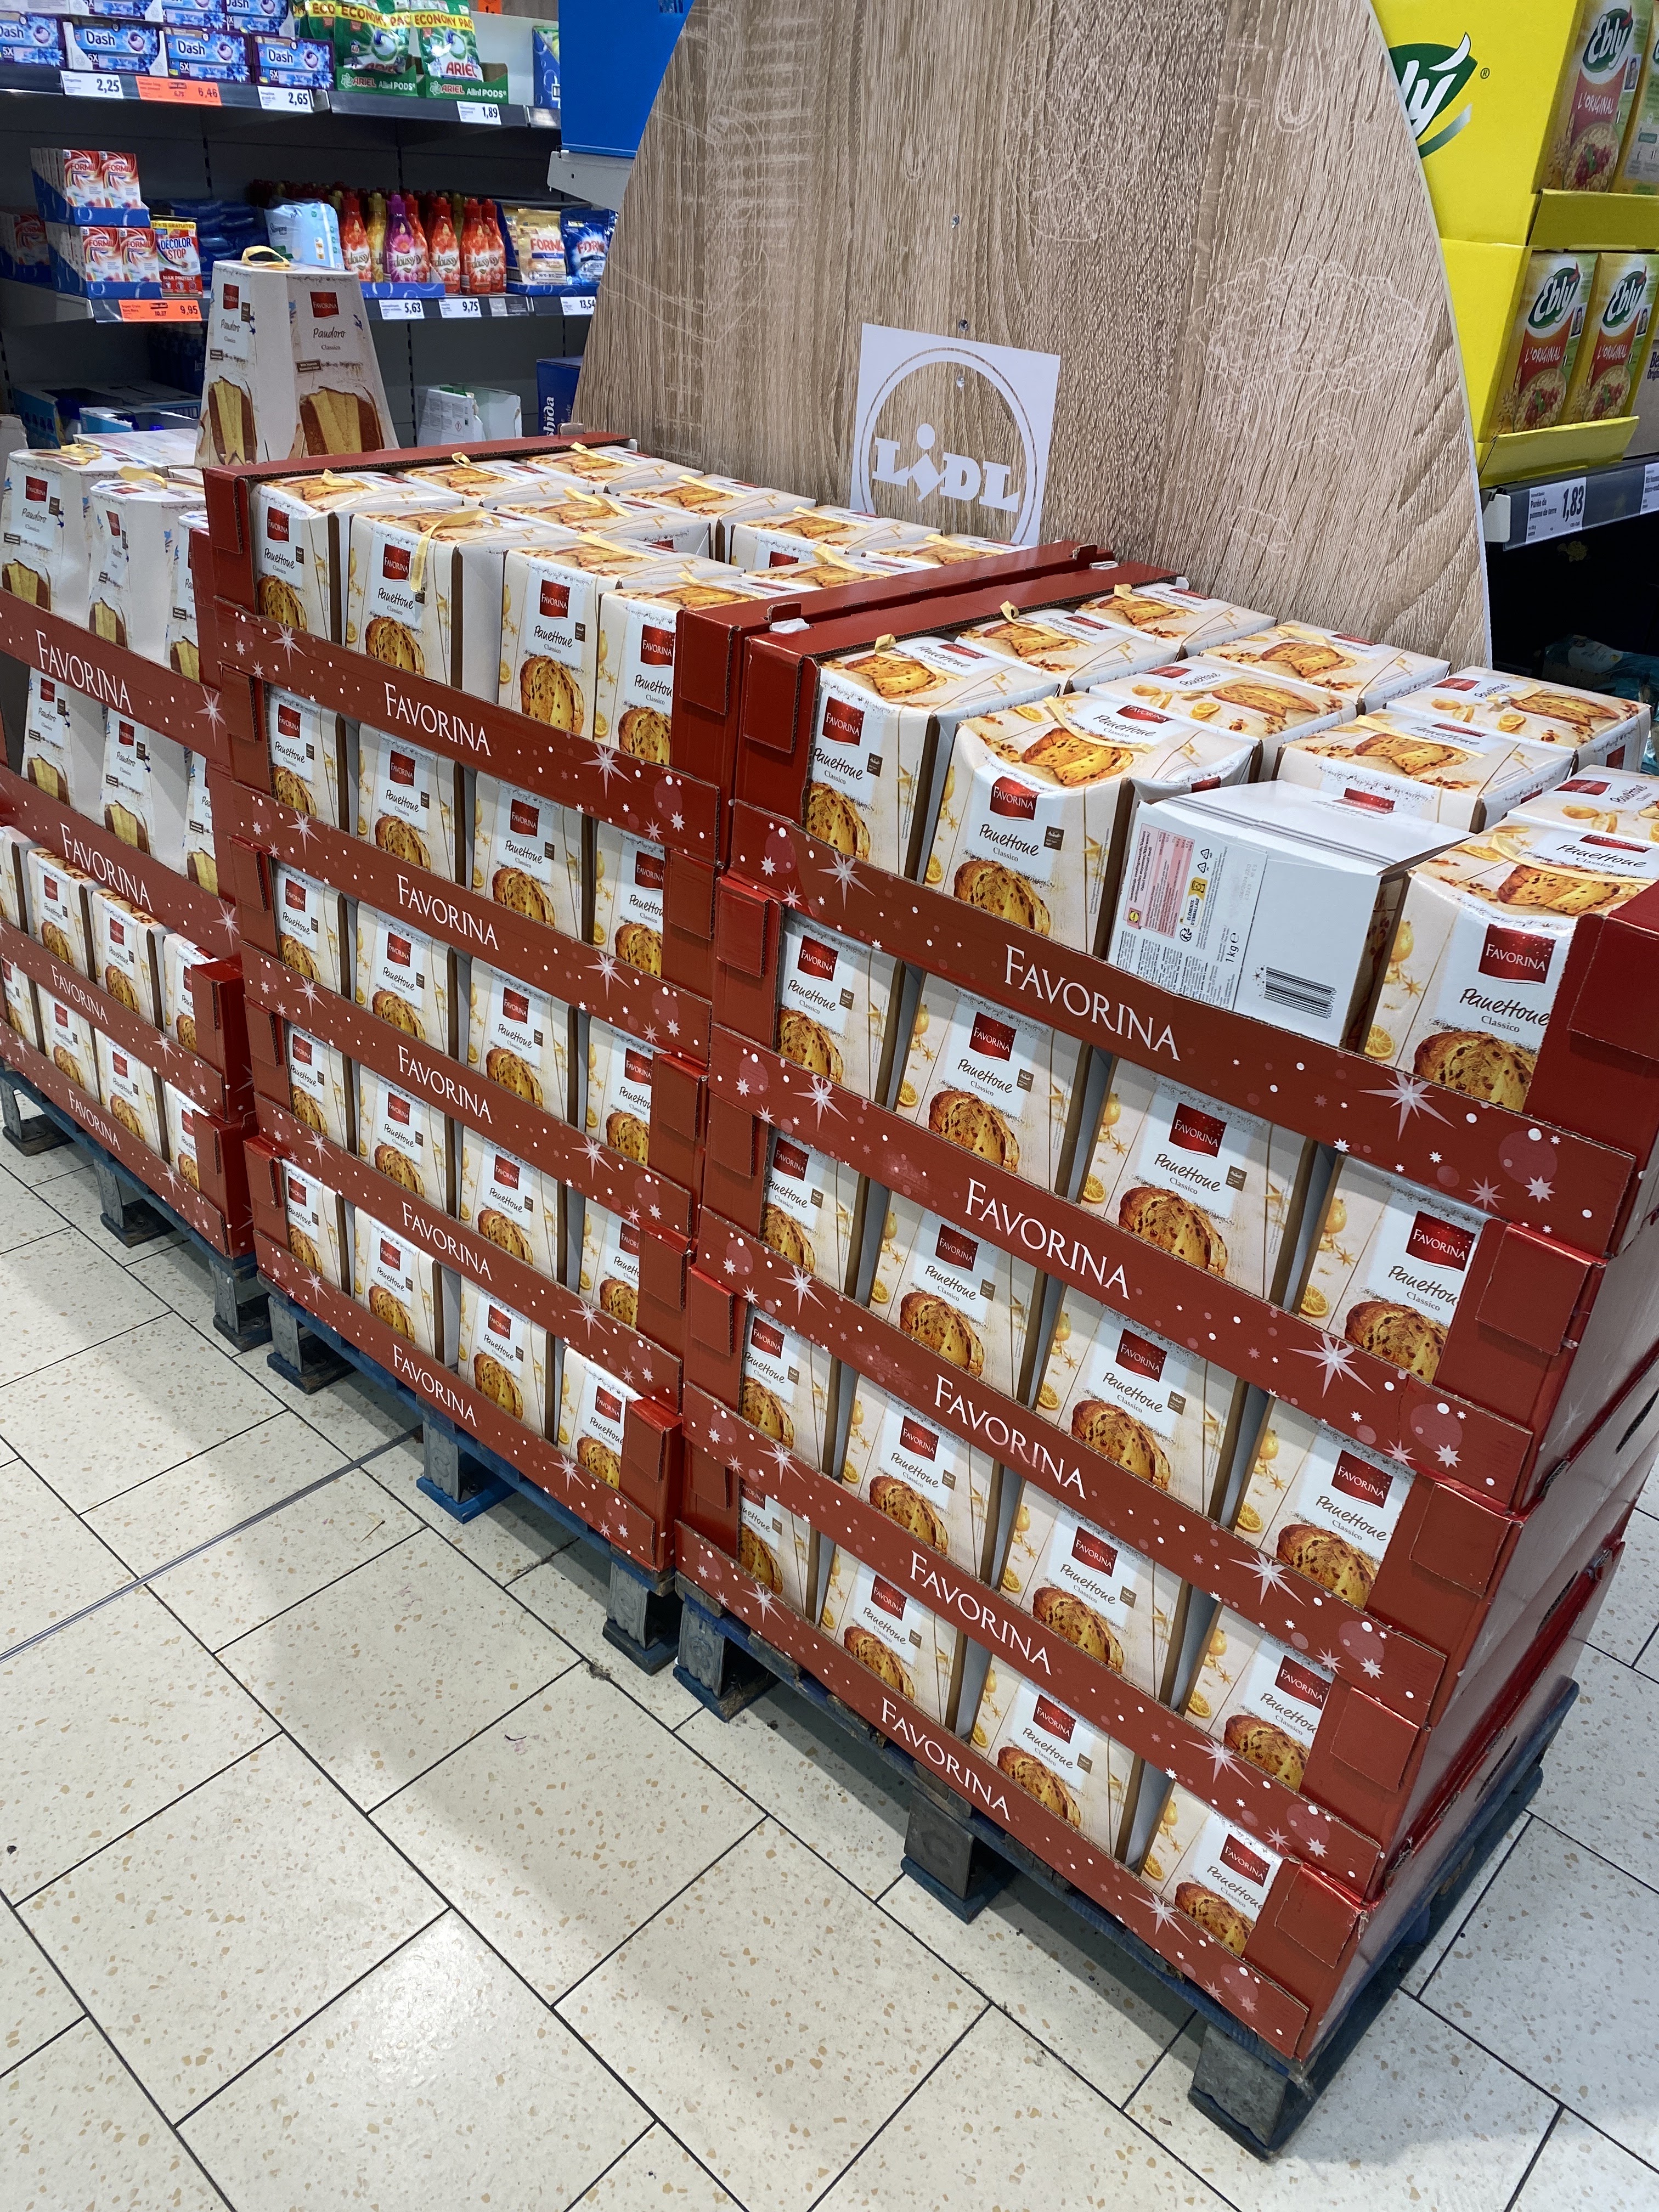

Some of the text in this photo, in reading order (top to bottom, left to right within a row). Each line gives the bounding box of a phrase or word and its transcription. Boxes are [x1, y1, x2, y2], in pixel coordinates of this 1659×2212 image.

[415, 14, 456, 27] ECONOMY
[86, 31, 115, 46] Dash
[178, 40, 205, 55] Dash
[1588, 14, 1629, 69] Ebly
[179, 62, 189, 71] 5X
[269, 49, 293, 63] Dash
[269, 70, 279, 79] 5X
[446, 61, 477, 77] ARIEL
[97, 78, 119, 93] 2,25
[198, 87, 217, 98] 6,46
[352, 77, 376, 87] ARIEL
[441, 84, 464, 94] ARIEL
[288, 92, 308, 105] 2,65
[1577, 92, 1614, 115] L'ORIGINAL
[483, 106, 498, 119] 1,89
[168, 249, 185, 259] STOP
[180, 306, 198, 315] 9,95
[313, 301, 337, 309] FAVORINA
[405, 302, 421, 314] 5,63
[462, 301, 478, 312] 9,75
[1535, 276, 1579, 324] Ebly
[1609, 278, 1641, 324] Ebly
[313, 327, 346, 338] Pandoro
[1525, 346, 1561, 364] L'ORIGINAL
[1597, 345, 1627, 360] L'ORIGINAL
[1563, 485, 1584, 522] 1,83
[268, 518, 289, 535] FAVORINA
[264, 548, 295, 569] Panettone
[385, 557, 408, 573] FAVORINA
[378, 588, 414, 610] Panettone
[541, 593, 567, 610] FAVORINA
[534, 625, 573, 647] Panettone
[642, 640, 672, 657] FAVORINA
[35, 629, 133, 714] FAVORINA
[634, 674, 673, 697] Panetton
[646, 694, 665, 705] Classico
[279, 715, 299, 732] FAVORINA
[385, 682, 491, 757] FAVORINA
[826, 712, 860, 737] FAVORINA
[1126, 705, 1167, 721] FAVORINA
[1093, 715, 1156, 736] Panettone
[275, 741, 305, 763] Panettone
[813, 747, 863, 780] Panettone
[391, 763, 413, 780] FAVORINA
[824, 769, 847, 786] Classico
[386, 789, 420, 812] Panettone
[993, 786, 1034, 811] FAVORINA
[512, 811, 537, 830] FAVORINA
[981, 823, 1040, 856] Panettone
[505, 840, 543, 864] Panettone
[993, 847, 1019, 862] Classico
[1556, 845, 1647, 867] Panettone
[60, 822, 153, 913] FAVORINA
[286, 889, 305, 906] FAVORINA
[283, 912, 310, 935] Panettone
[397, 873, 500, 951] FAVORINA
[388, 943, 410, 960] FAVORINA
[801, 949, 833, 973] FAVORINA
[1227, 945, 1239, 958] kg
[1485, 943, 1546, 972] FAVORINA
[383, 967, 415, 991] Panettone
[50, 964, 109, 1025] FAVORINA
[788, 979, 836, 1012] Panettone
[799, 999, 820, 1014] Classico
[1004, 943, 1181, 1062] FAVORINA
[504, 1000, 527, 1017] FAVORINA
[1459, 988, 1551, 1027] Panettone
[498, 1023, 532, 1048] Panettone
[1481, 1014, 1520, 1033] Classico
[974, 1027, 1011, 1052] FAVORINA
[627, 1059, 651, 1080] FAVORINA
[957, 1058, 1013, 1093] Panettone
[397, 1045, 493, 1124] FAVORINA
[970, 1080, 994, 1097] Classico
[69, 1088, 120, 1151] FAVORINA
[384, 1124, 415, 1148] Panettone
[1175, 1119, 1218, 1148] FAVORINA
[776, 1149, 805, 1174] FAVORINA
[1154, 1153, 1221, 1192] Panettone
[1170, 1176, 1198, 1195] Classico
[489, 1188, 522, 1213] Panettone
[402, 1201, 493, 1281] FAVORINA
[939, 1237, 973, 1264] FAVORINA
[964, 1177, 1130, 1300] FAVORINA
[1413, 1228, 1466, 1261] FAVORINA
[377, 1267, 405, 1291] Panettone
[925, 1265, 976, 1301] Panettone
[1388, 1265, 1459, 1306] Panetton
[1407, 1291, 1441, 1311] Classico
[484, 1334, 514, 1361] Panettone
[753, 1328, 781, 1352] FAVORINA
[1120, 1344, 1160, 1373] FAVORINA
[393, 1344, 477, 1427] FAVORINA
[1103, 1372, 1163, 1413] Panettone
[597, 1398, 620, 1418] FAVORINA
[902, 1427, 935, 1455] FAVORINA
[934, 1373, 1086, 1500] FAVORINA
[890, 1453, 939, 1488] Panettone
[1338, 1465, 1385, 1499] FAVORINA
[1316, 1496, 1386, 1541] Panettone
[1332, 1520, 1362, 1541] Classico
[1075, 1539, 1113, 1570] FAVORINA
[1060, 1564, 1116, 1605] Panettone
[873, 1586, 902, 1615] FAVORINA
[910, 1550, 1052, 1675] FAVORINA
[863, 1607, 906, 1645] Panettone
[1280, 1668, 1323, 1702] FAVORINA
[1037, 1706, 1070, 1737] FAVORINA
[1261, 1692, 1317, 1734] Panetton
[882, 1696, 1011, 1822] FAVORINA
[1023, 1727, 1073, 1769] Panettone
[1224, 1845, 1265, 1881] FAVORINA
